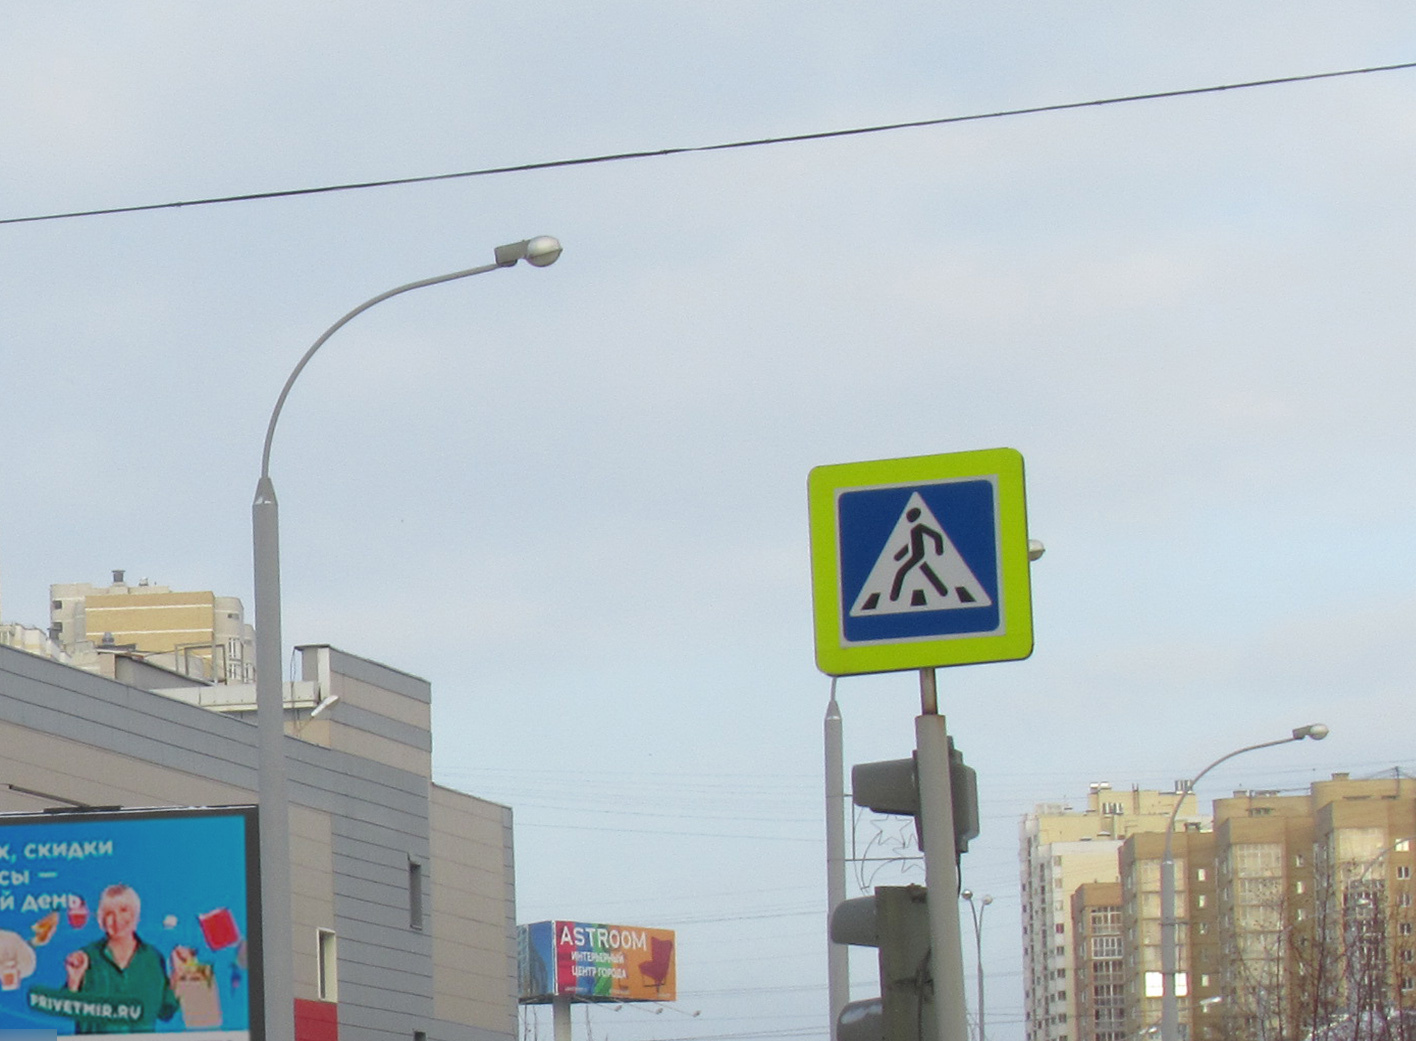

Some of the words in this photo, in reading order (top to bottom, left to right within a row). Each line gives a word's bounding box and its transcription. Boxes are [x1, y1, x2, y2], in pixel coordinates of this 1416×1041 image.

[23, 839, 114, 861] скидки
[21, 893, 84, 915] день
[559, 925, 648, 951] ASTROOM
[570, 950, 625, 964] ИНТЕРЬЕРНЫЙ
[571, 965, 597, 978] ЦЕНТР
[598, 966, 627, 979] ГОРОДА
[29, 992, 142, 1020] PRIVETMIR.RU
